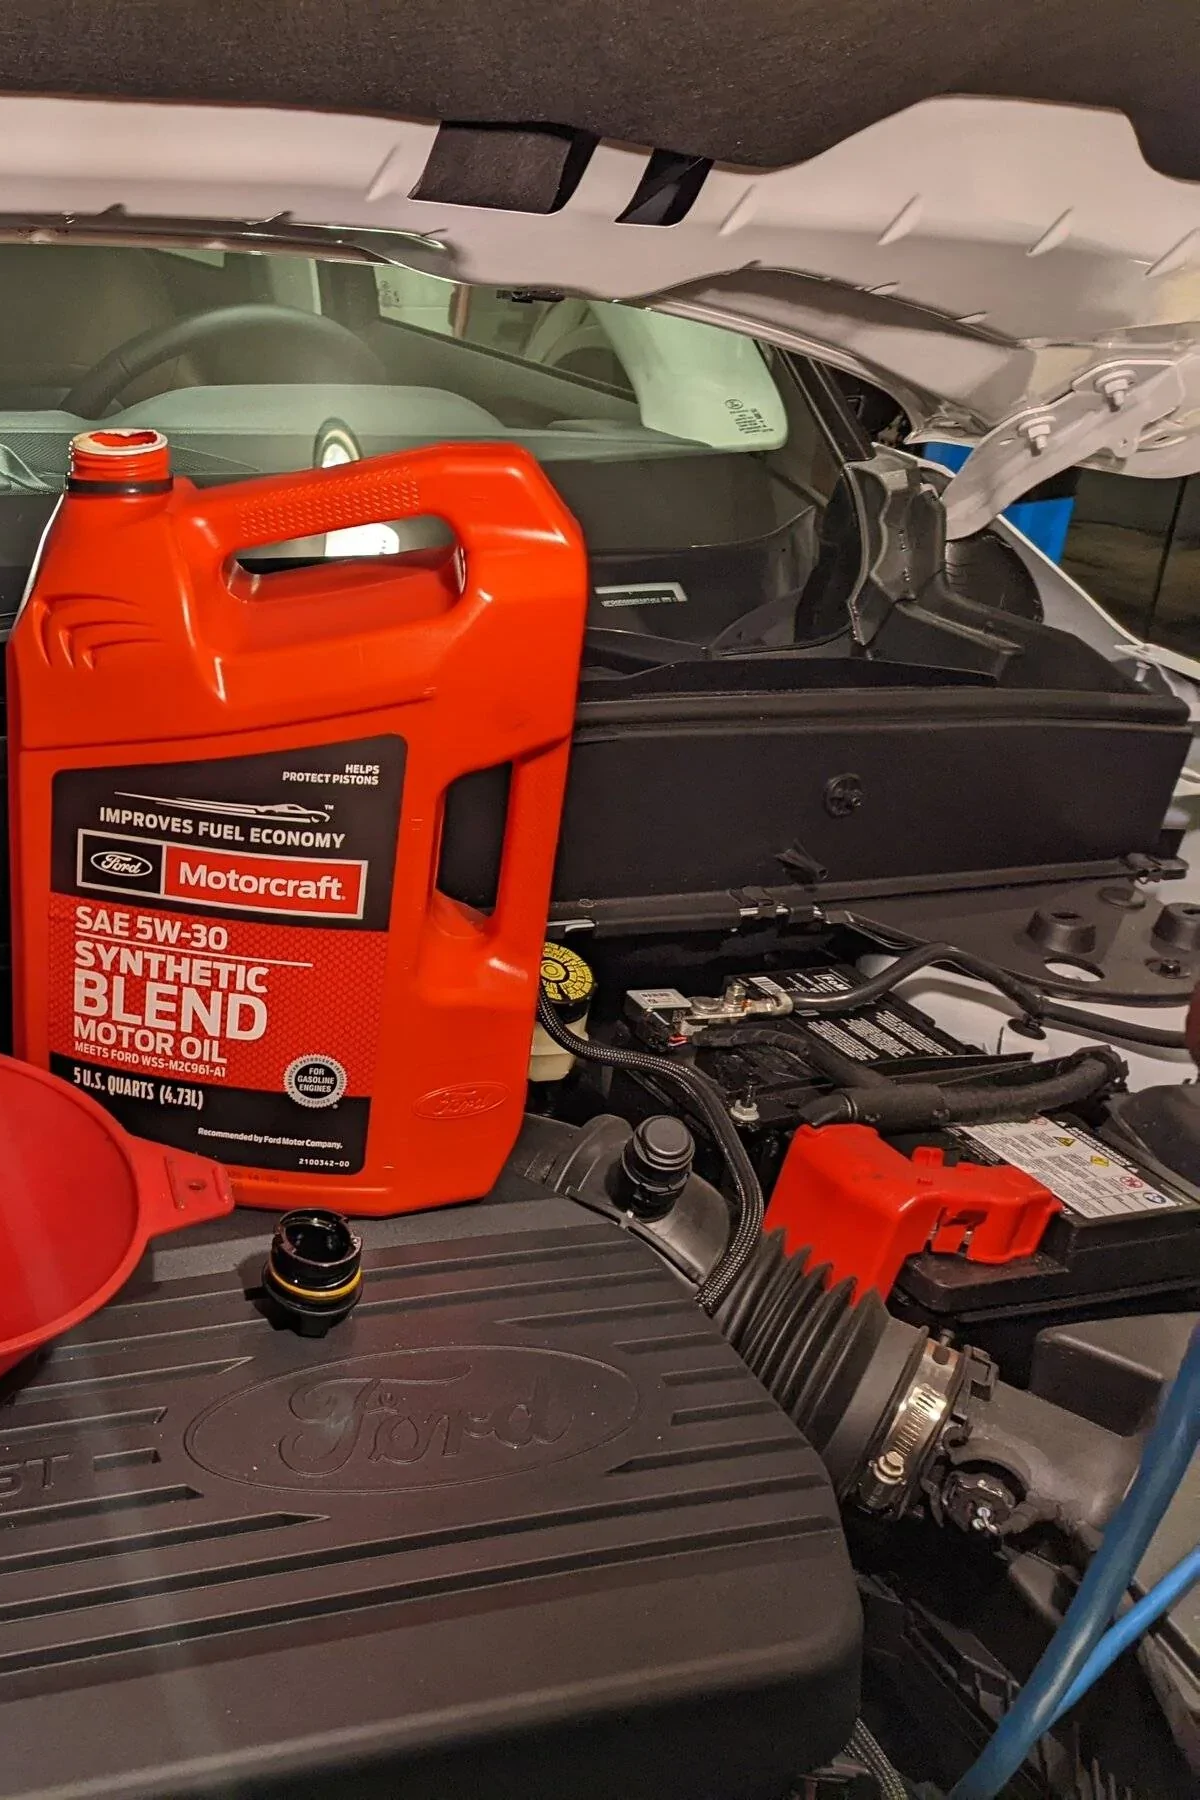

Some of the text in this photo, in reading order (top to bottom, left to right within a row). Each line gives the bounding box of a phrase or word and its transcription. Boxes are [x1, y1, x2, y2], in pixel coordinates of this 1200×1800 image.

[282, 771, 380, 786] PROTECT PISTONS
[345, 764, 380, 775] HELPS
[99, 806, 346, 849] IMPROVES FUEL ECONOMY
[100, 853, 142, 876] Ford
[75, 905, 229, 951] SAE 5W-30
[73, 939, 270, 994] SYNTHETIC
[73, 966, 269, 1042] BLEND
[73, 1015, 228, 1064] MOTOR OIL
[74, 1040, 226, 1078] MEETS FORD WSS-M2C961-A1
[308, 1067, 325, 1076] FOR
[73, 1066, 204, 1111] 5 U.S. QUARTS (4.73L)
[297, 1074, 335, 1085] GASOLINE
[298, 1083, 332, 1093] ENGINES
[197, 1127, 344, 1150] Recommended by Ford Motor Company.
[298, 1158, 351, 1168] 2100342-00
[278, 1364, 575, 1477] Ford
